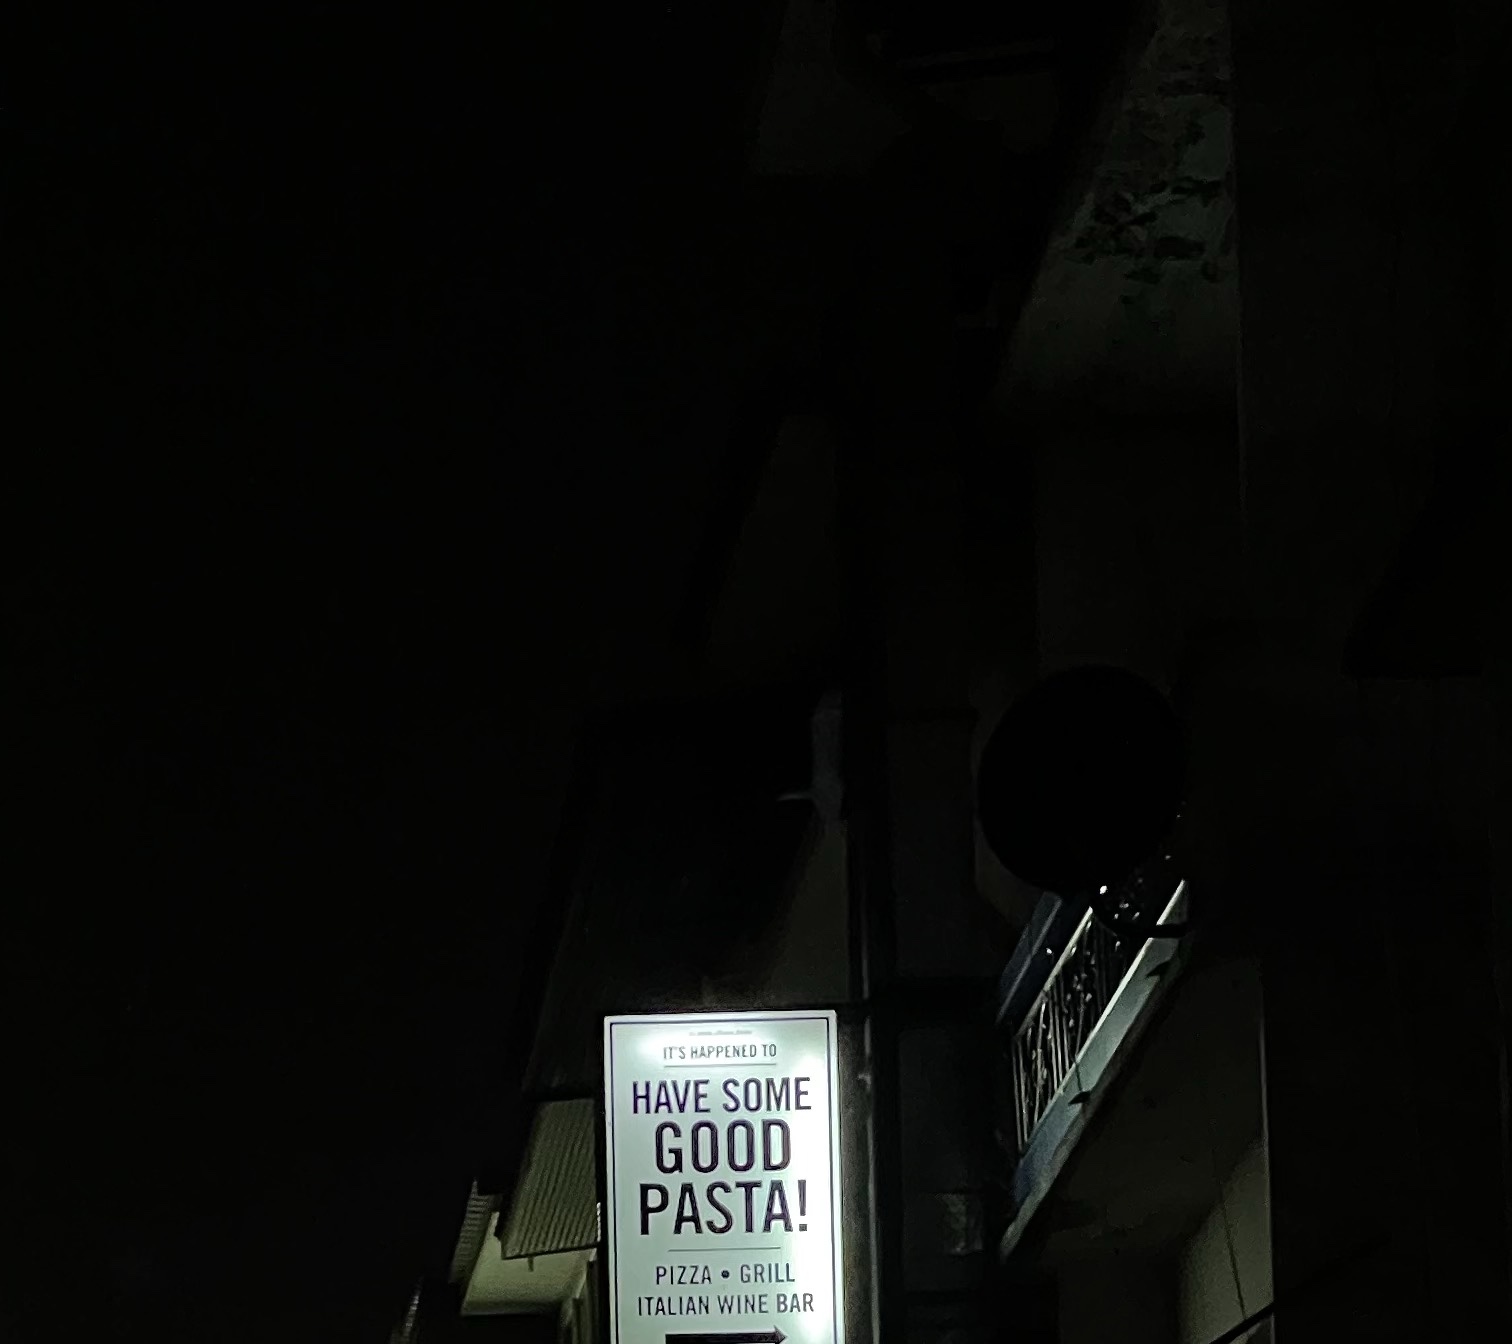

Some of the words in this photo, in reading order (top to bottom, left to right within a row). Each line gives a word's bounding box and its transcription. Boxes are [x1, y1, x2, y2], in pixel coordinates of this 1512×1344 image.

[663, 1045, 686, 1060] IT'S
[690, 1044, 757, 1059] HAPPENED
[762, 1043, 777, 1057] TO
[632, 1079, 711, 1115] HAVE
[722, 1076, 812, 1112] SOME
[655, 1118, 791, 1174] GOOD
[639, 1179, 808, 1236] PASTA!
[656, 1265, 712, 1285] PIZZA
[740, 1262, 796, 1284] GRILL
[638, 1295, 710, 1317] ITALIAN
[717, 1293, 769, 1315] WINE
[777, 1292, 815, 1314] BAR
